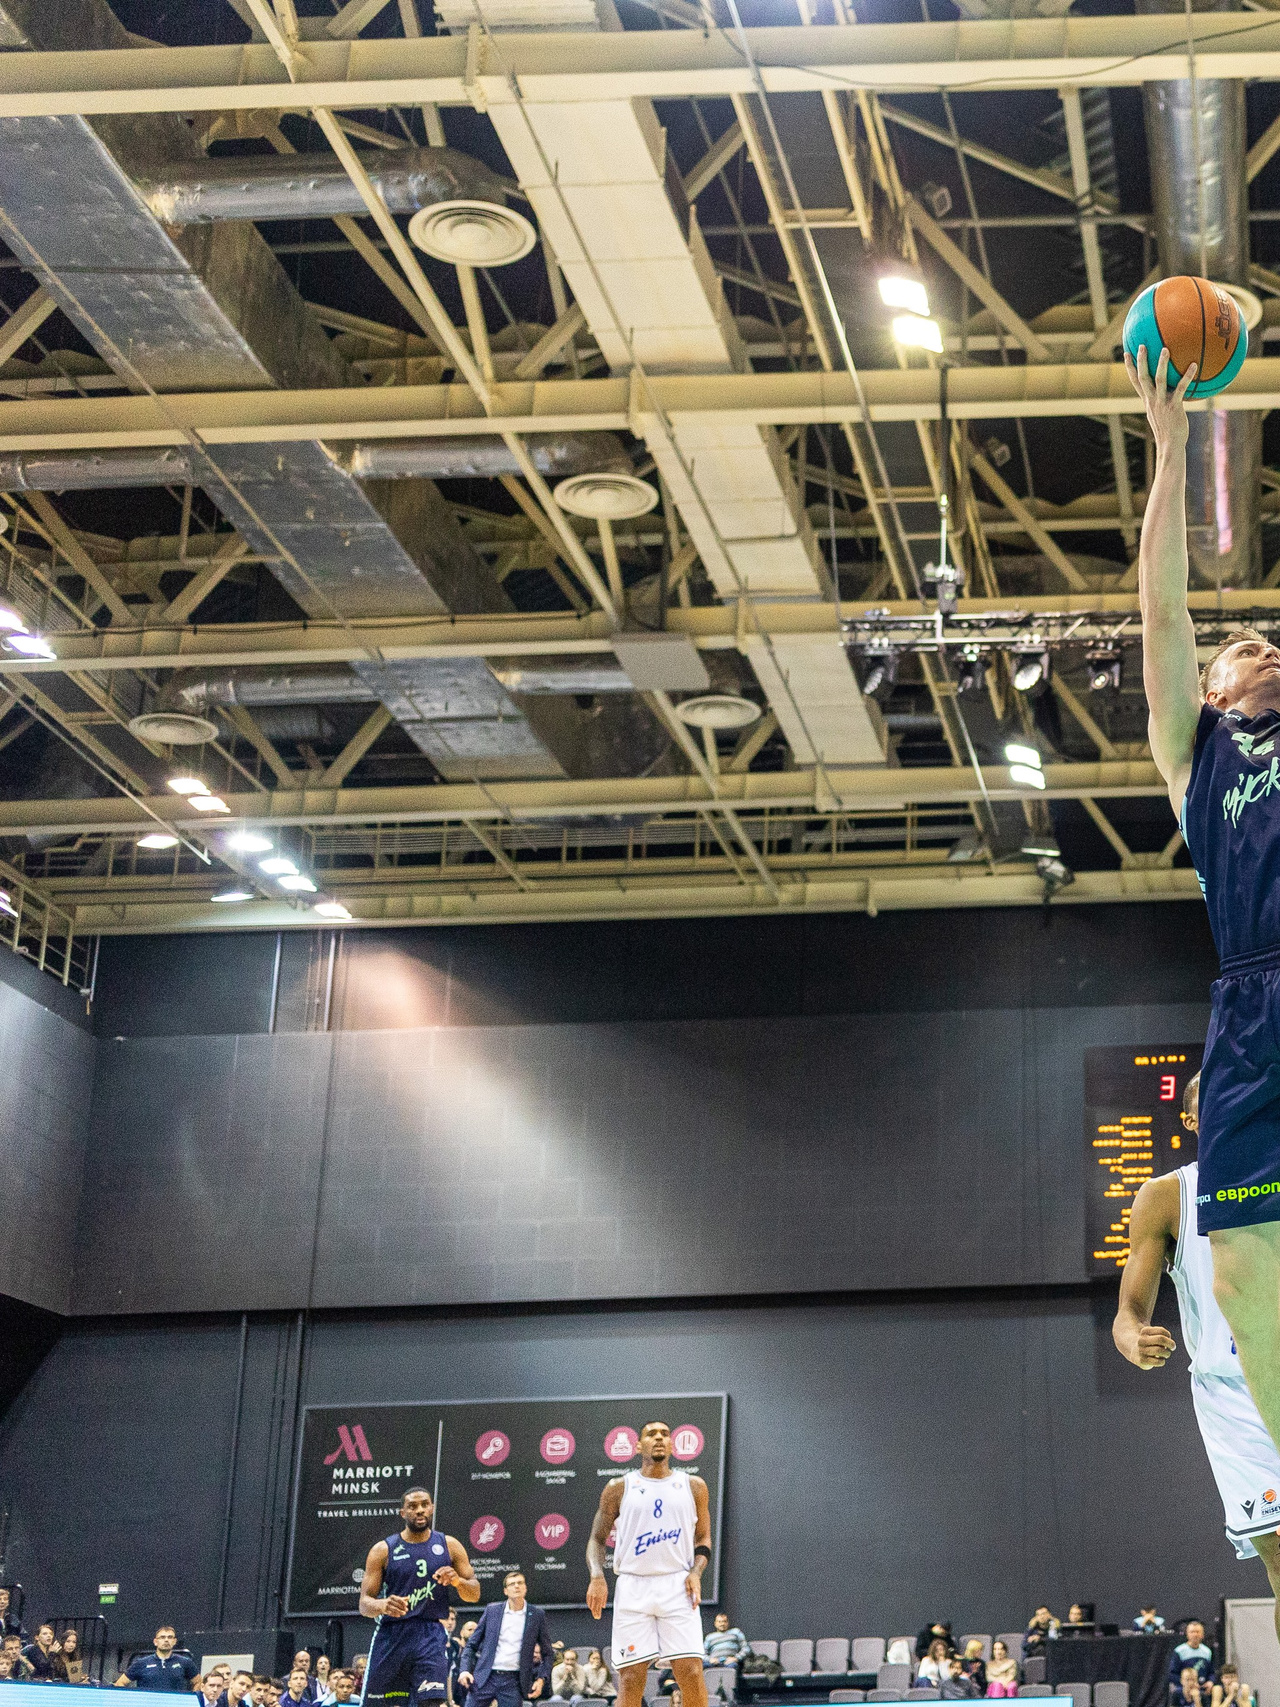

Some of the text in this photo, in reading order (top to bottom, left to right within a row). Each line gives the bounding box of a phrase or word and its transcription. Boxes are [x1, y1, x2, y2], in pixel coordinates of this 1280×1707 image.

[1160, 1075, 1176, 1100] 3
[333, 1465, 414, 1479] MARRIOTT
[332, 1482, 380, 1494] MINSK
[653, 1498, 663, 1518] 8
[541, 1524, 565, 1538] VIP
[635, 1528, 681, 1556] Enisey
[416, 1559, 427, 1577] 3
